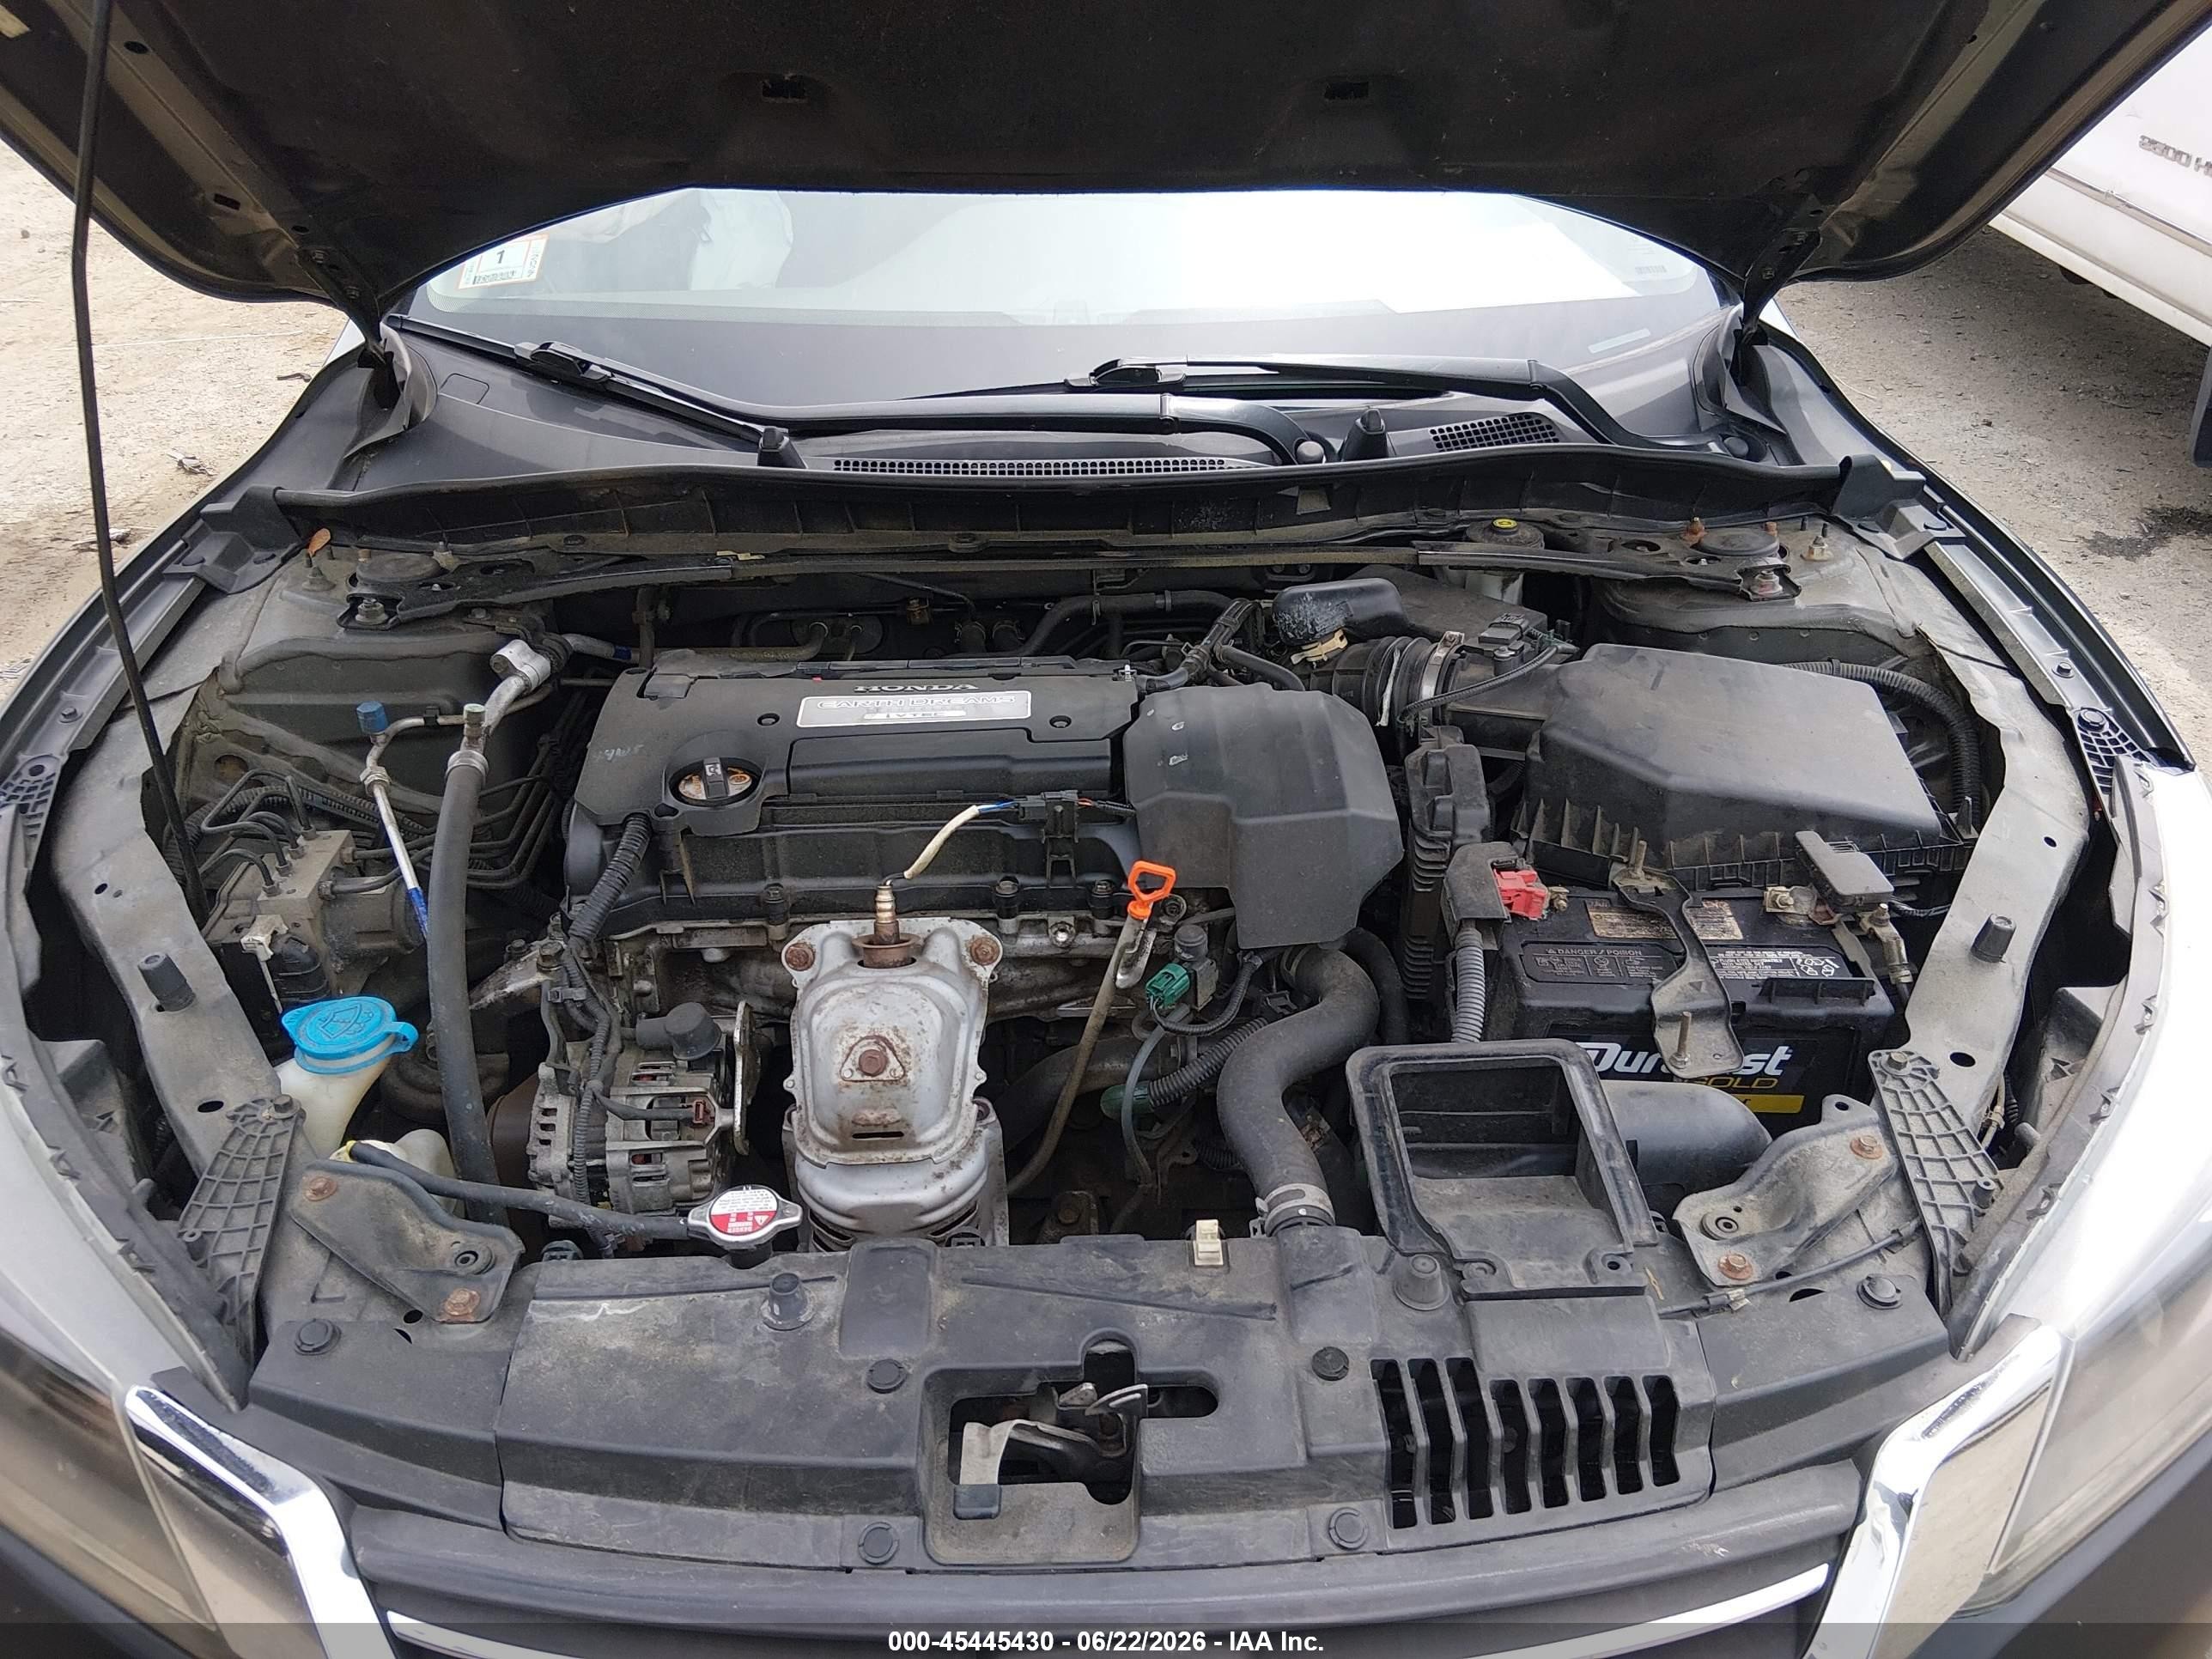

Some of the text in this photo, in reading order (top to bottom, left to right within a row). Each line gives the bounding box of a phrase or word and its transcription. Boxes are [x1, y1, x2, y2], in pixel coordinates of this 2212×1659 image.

[495, 249, 506, 264] 1
[854, 684, 980, 693] HONDA
[817, 695, 1017, 708] EARTH DREAMS
